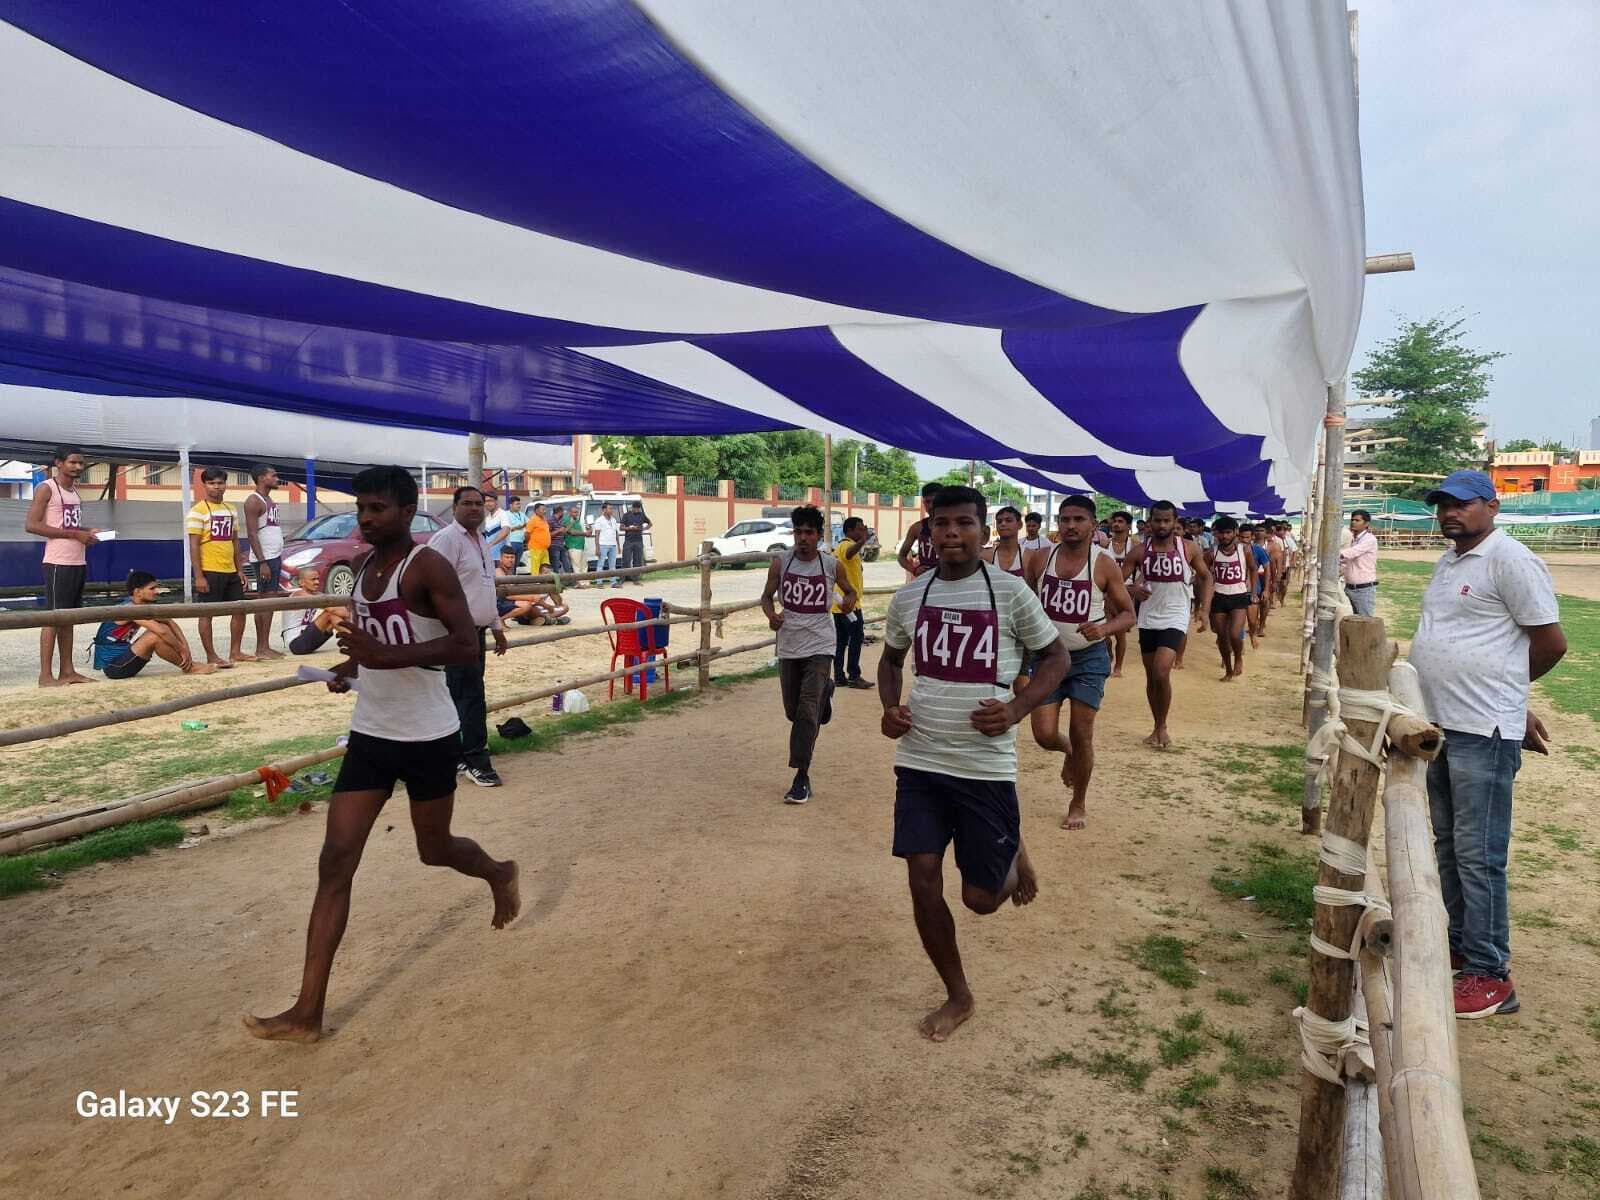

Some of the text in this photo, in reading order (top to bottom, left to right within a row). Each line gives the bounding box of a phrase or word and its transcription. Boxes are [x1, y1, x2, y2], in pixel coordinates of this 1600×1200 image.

[212, 520, 232, 537] 571
[1144, 556, 1183, 576] 1496
[1215, 566, 1242, 580] 1753
[784, 580, 825, 607] 2922
[1042, 584, 1090, 615] 1480
[917, 620, 996, 668] 1474
